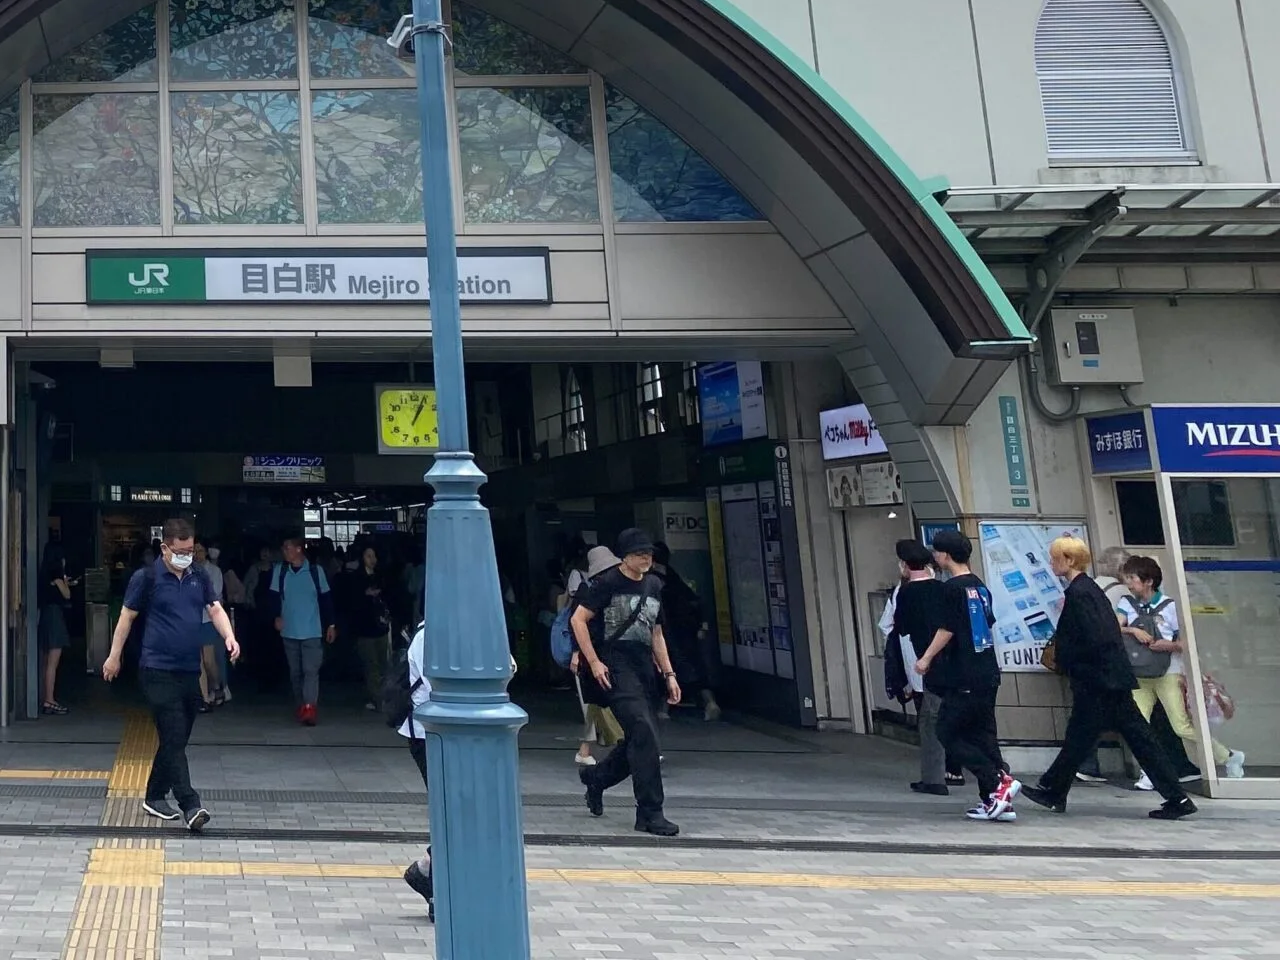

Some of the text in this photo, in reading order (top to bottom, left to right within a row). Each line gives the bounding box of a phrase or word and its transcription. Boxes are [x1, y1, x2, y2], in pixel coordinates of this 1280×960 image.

[128, 263, 170, 287] JR
[242, 263, 337, 294] 目白駅
[348, 275, 420, 298] Mejiro
[134, 287, 165, 295] JR東日本
[1095, 429, 1143, 451] みずほ銀行
[1015, 470, 1021, 480] 3
